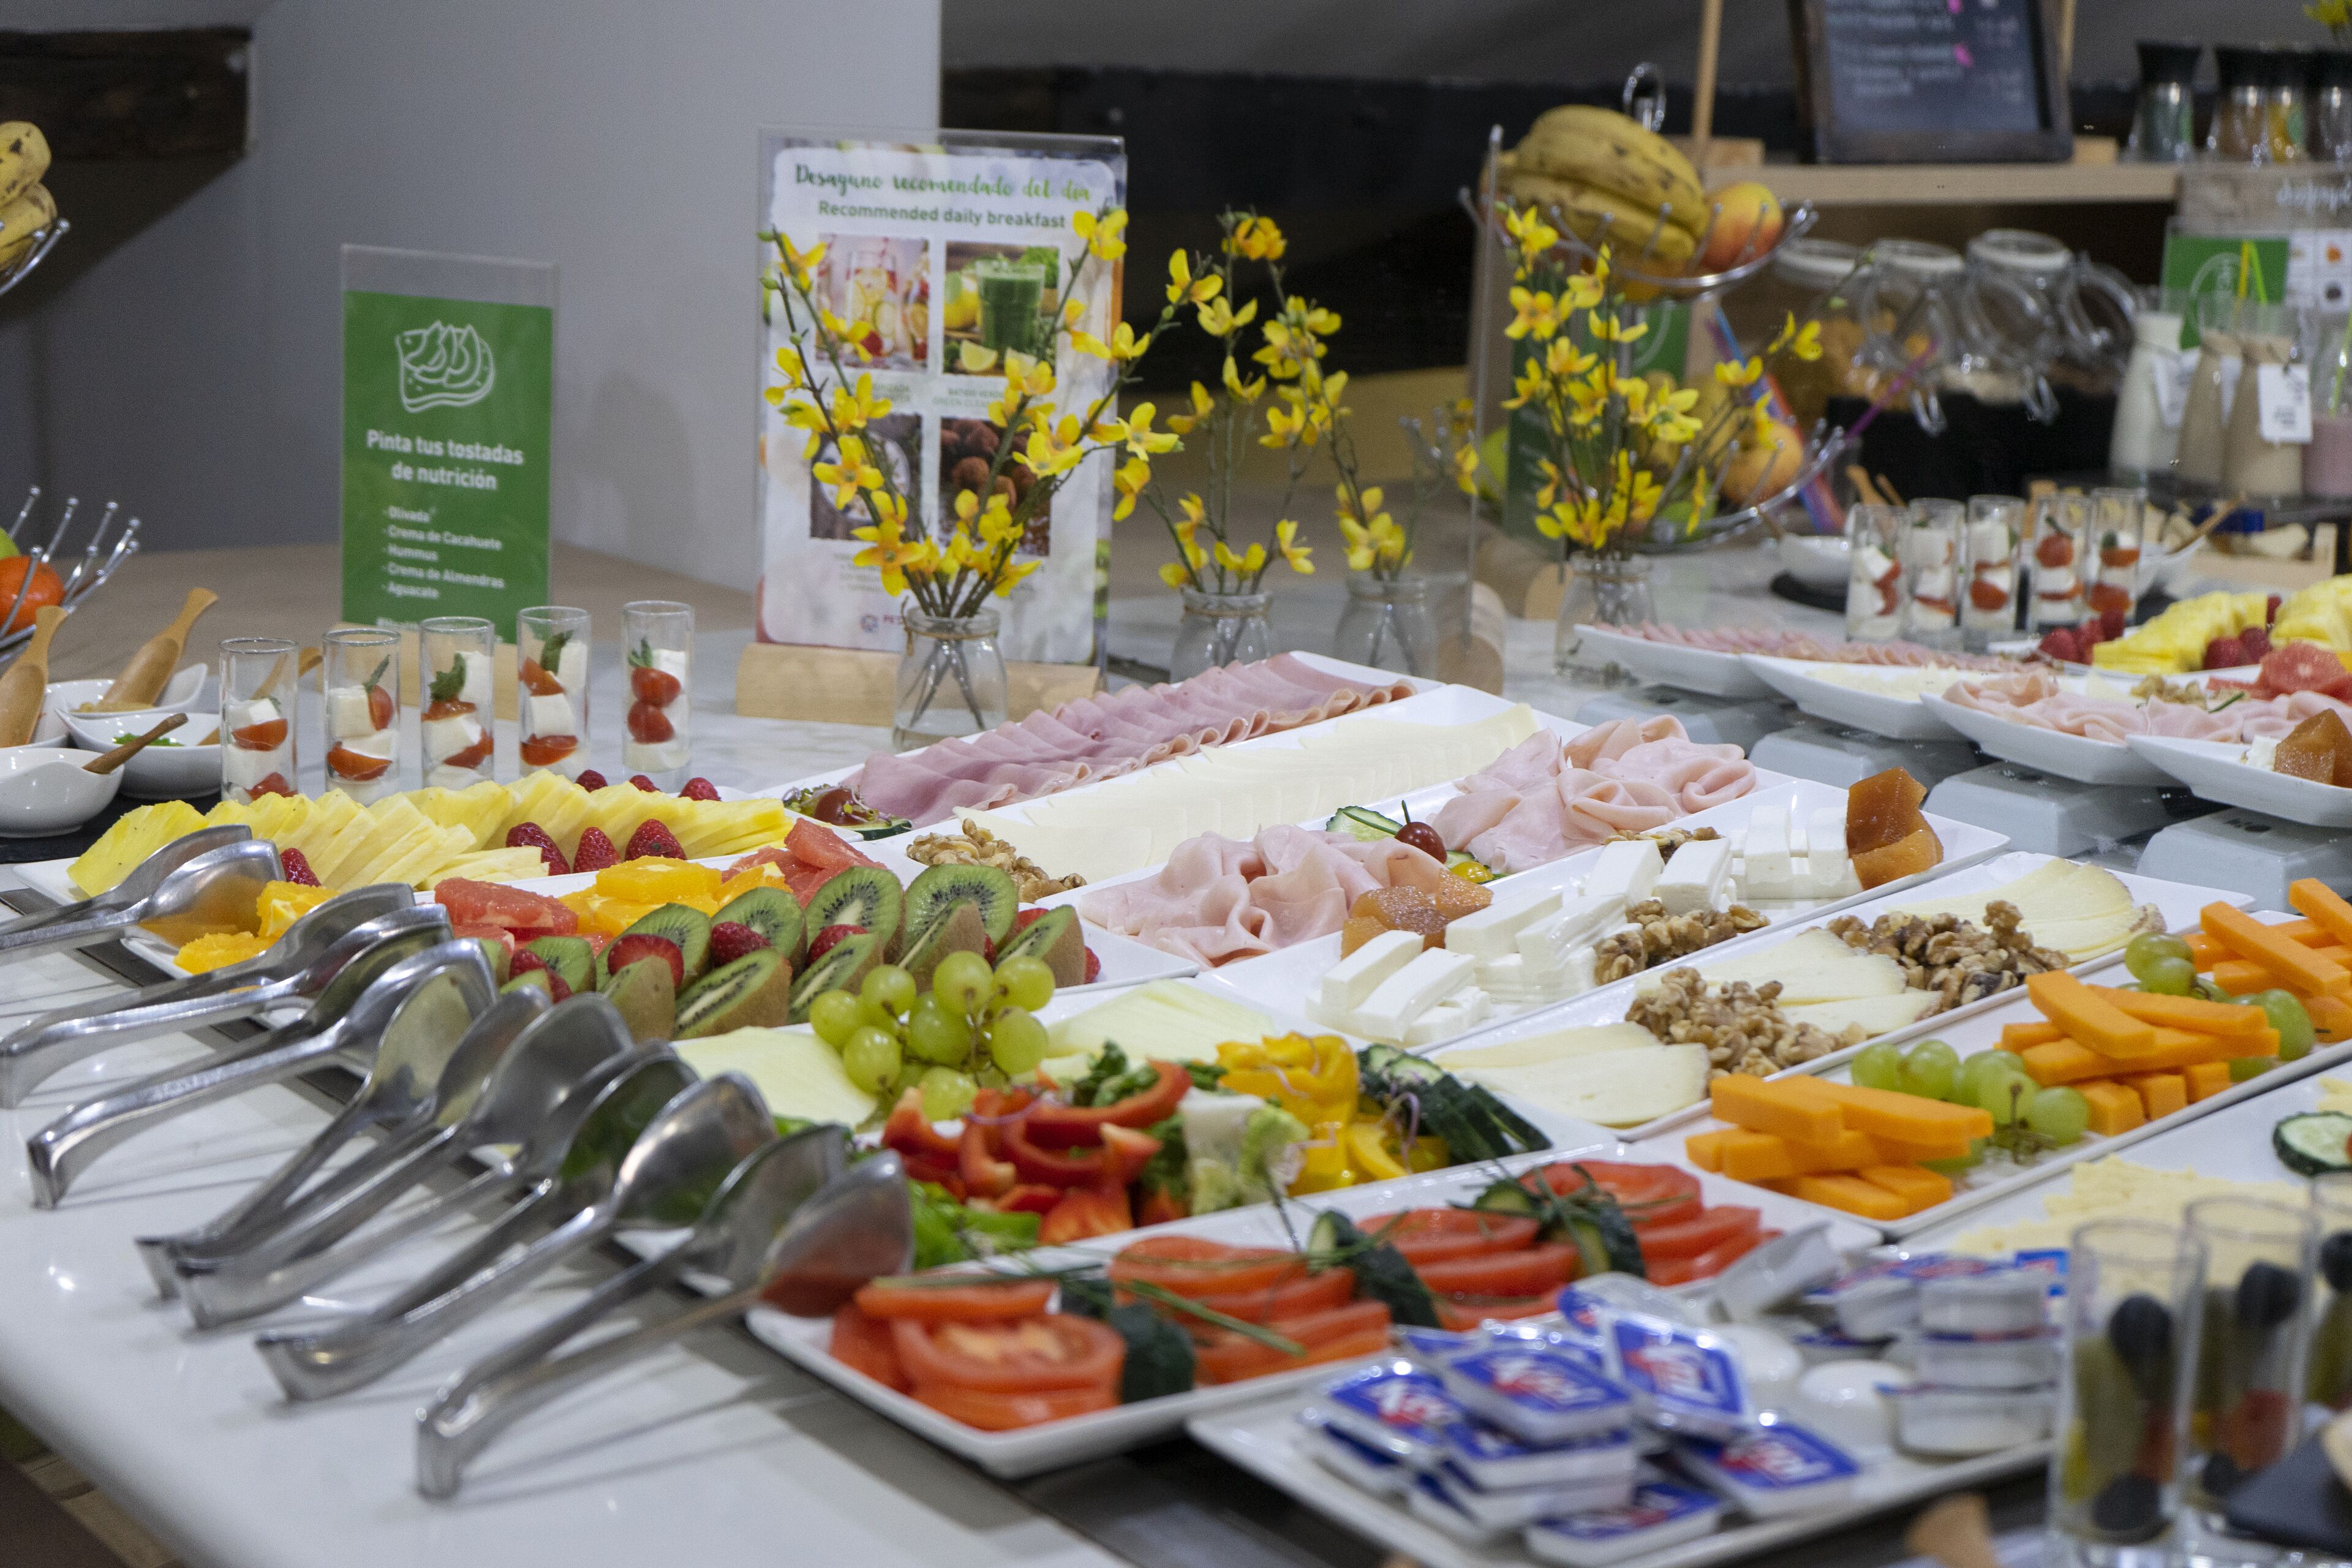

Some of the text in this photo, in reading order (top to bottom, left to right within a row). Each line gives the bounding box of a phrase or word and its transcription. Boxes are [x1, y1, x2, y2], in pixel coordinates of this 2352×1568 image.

[796, 164, 883, 197] Desayuno
[892, 174, 1012, 197] recomendado
[1022, 176, 1050, 199] del
[818, 200, 1065, 228] Recommended daily breakfast
[368, 429, 522, 465] Pinta tus tostadas
[391, 461, 497, 490] de nutrición
[388, 506, 430, 523] Olivada
[388, 525, 502, 550] Crema de Cacahuete
[388, 543, 439, 562] Hummus
[388, 562, 505, 589] Crema de Almendras
[388, 582, 439, 600] Aguacate
